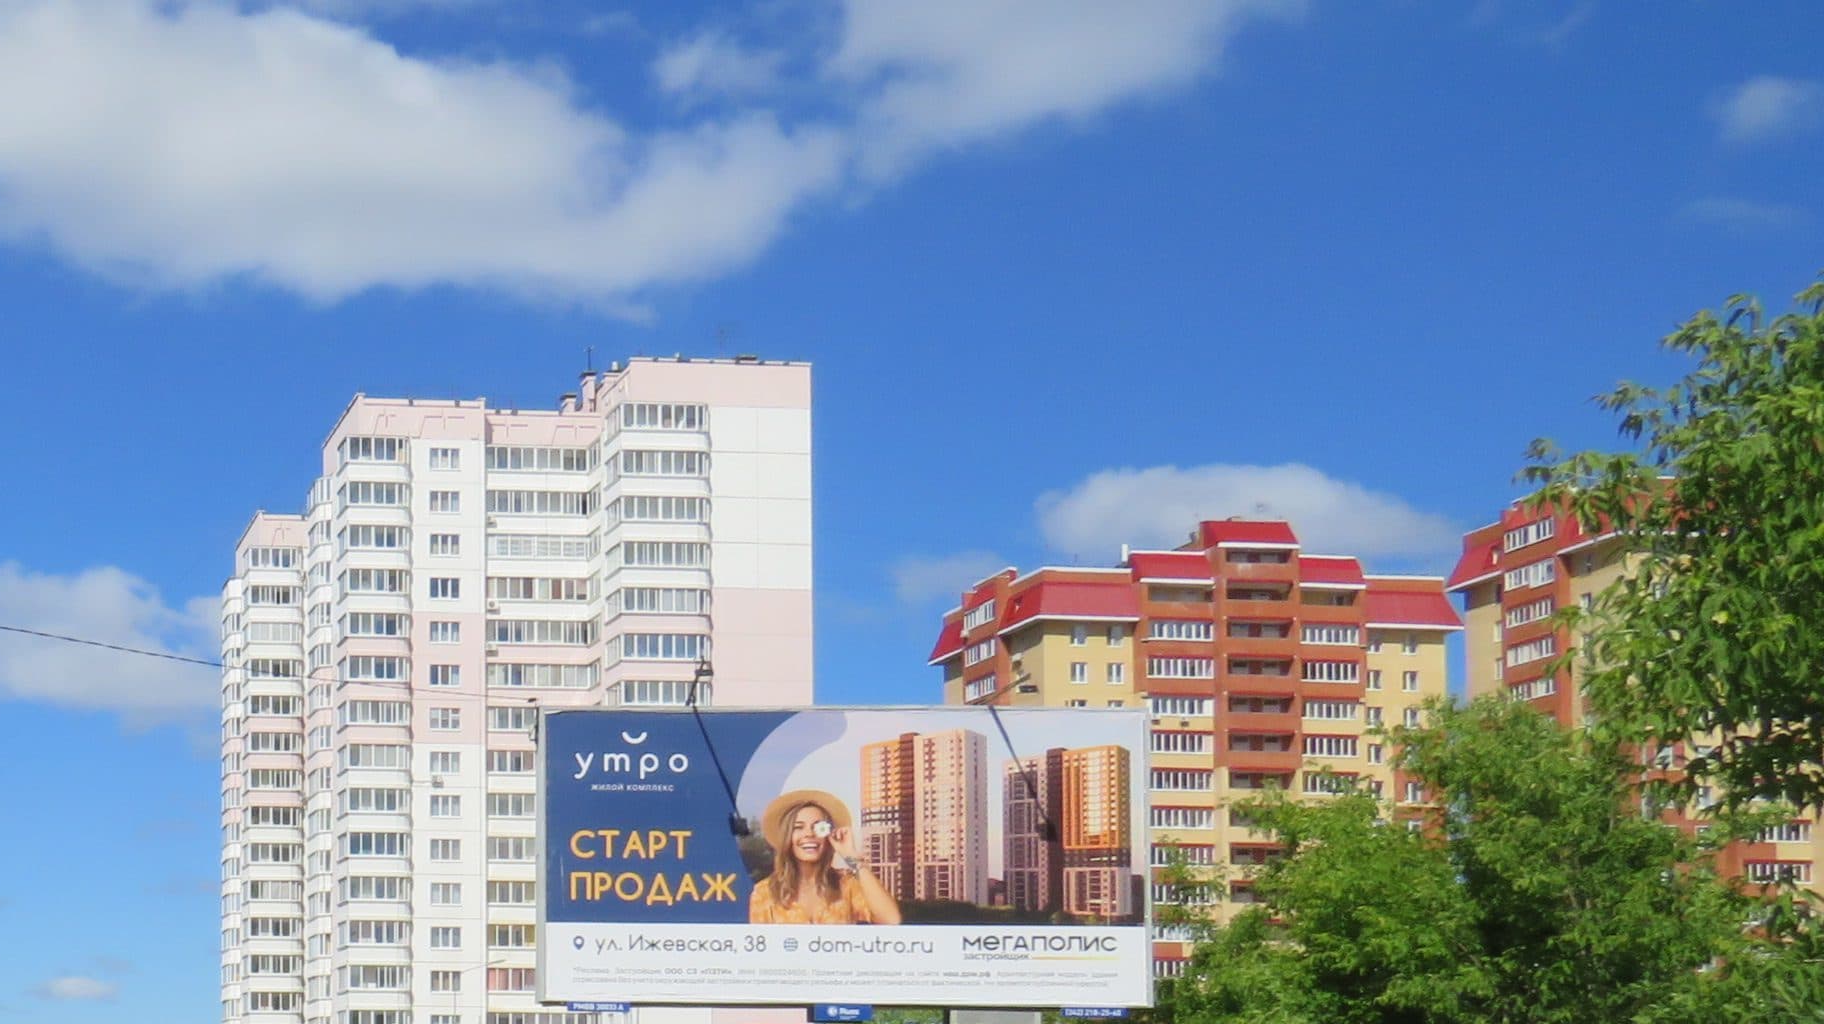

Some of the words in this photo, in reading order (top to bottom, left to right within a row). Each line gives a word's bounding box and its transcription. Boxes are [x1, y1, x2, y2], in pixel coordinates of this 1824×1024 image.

[569, 829, 693, 860] СТАРТ
[569, 871, 738, 907] ПРОДАЖ
[594, 937, 623, 955] ул.
[628, 934, 738, 955] Ижевская,
[743, 934, 767, 953] 38
[808, 935, 934, 955] dom-utro.ru
